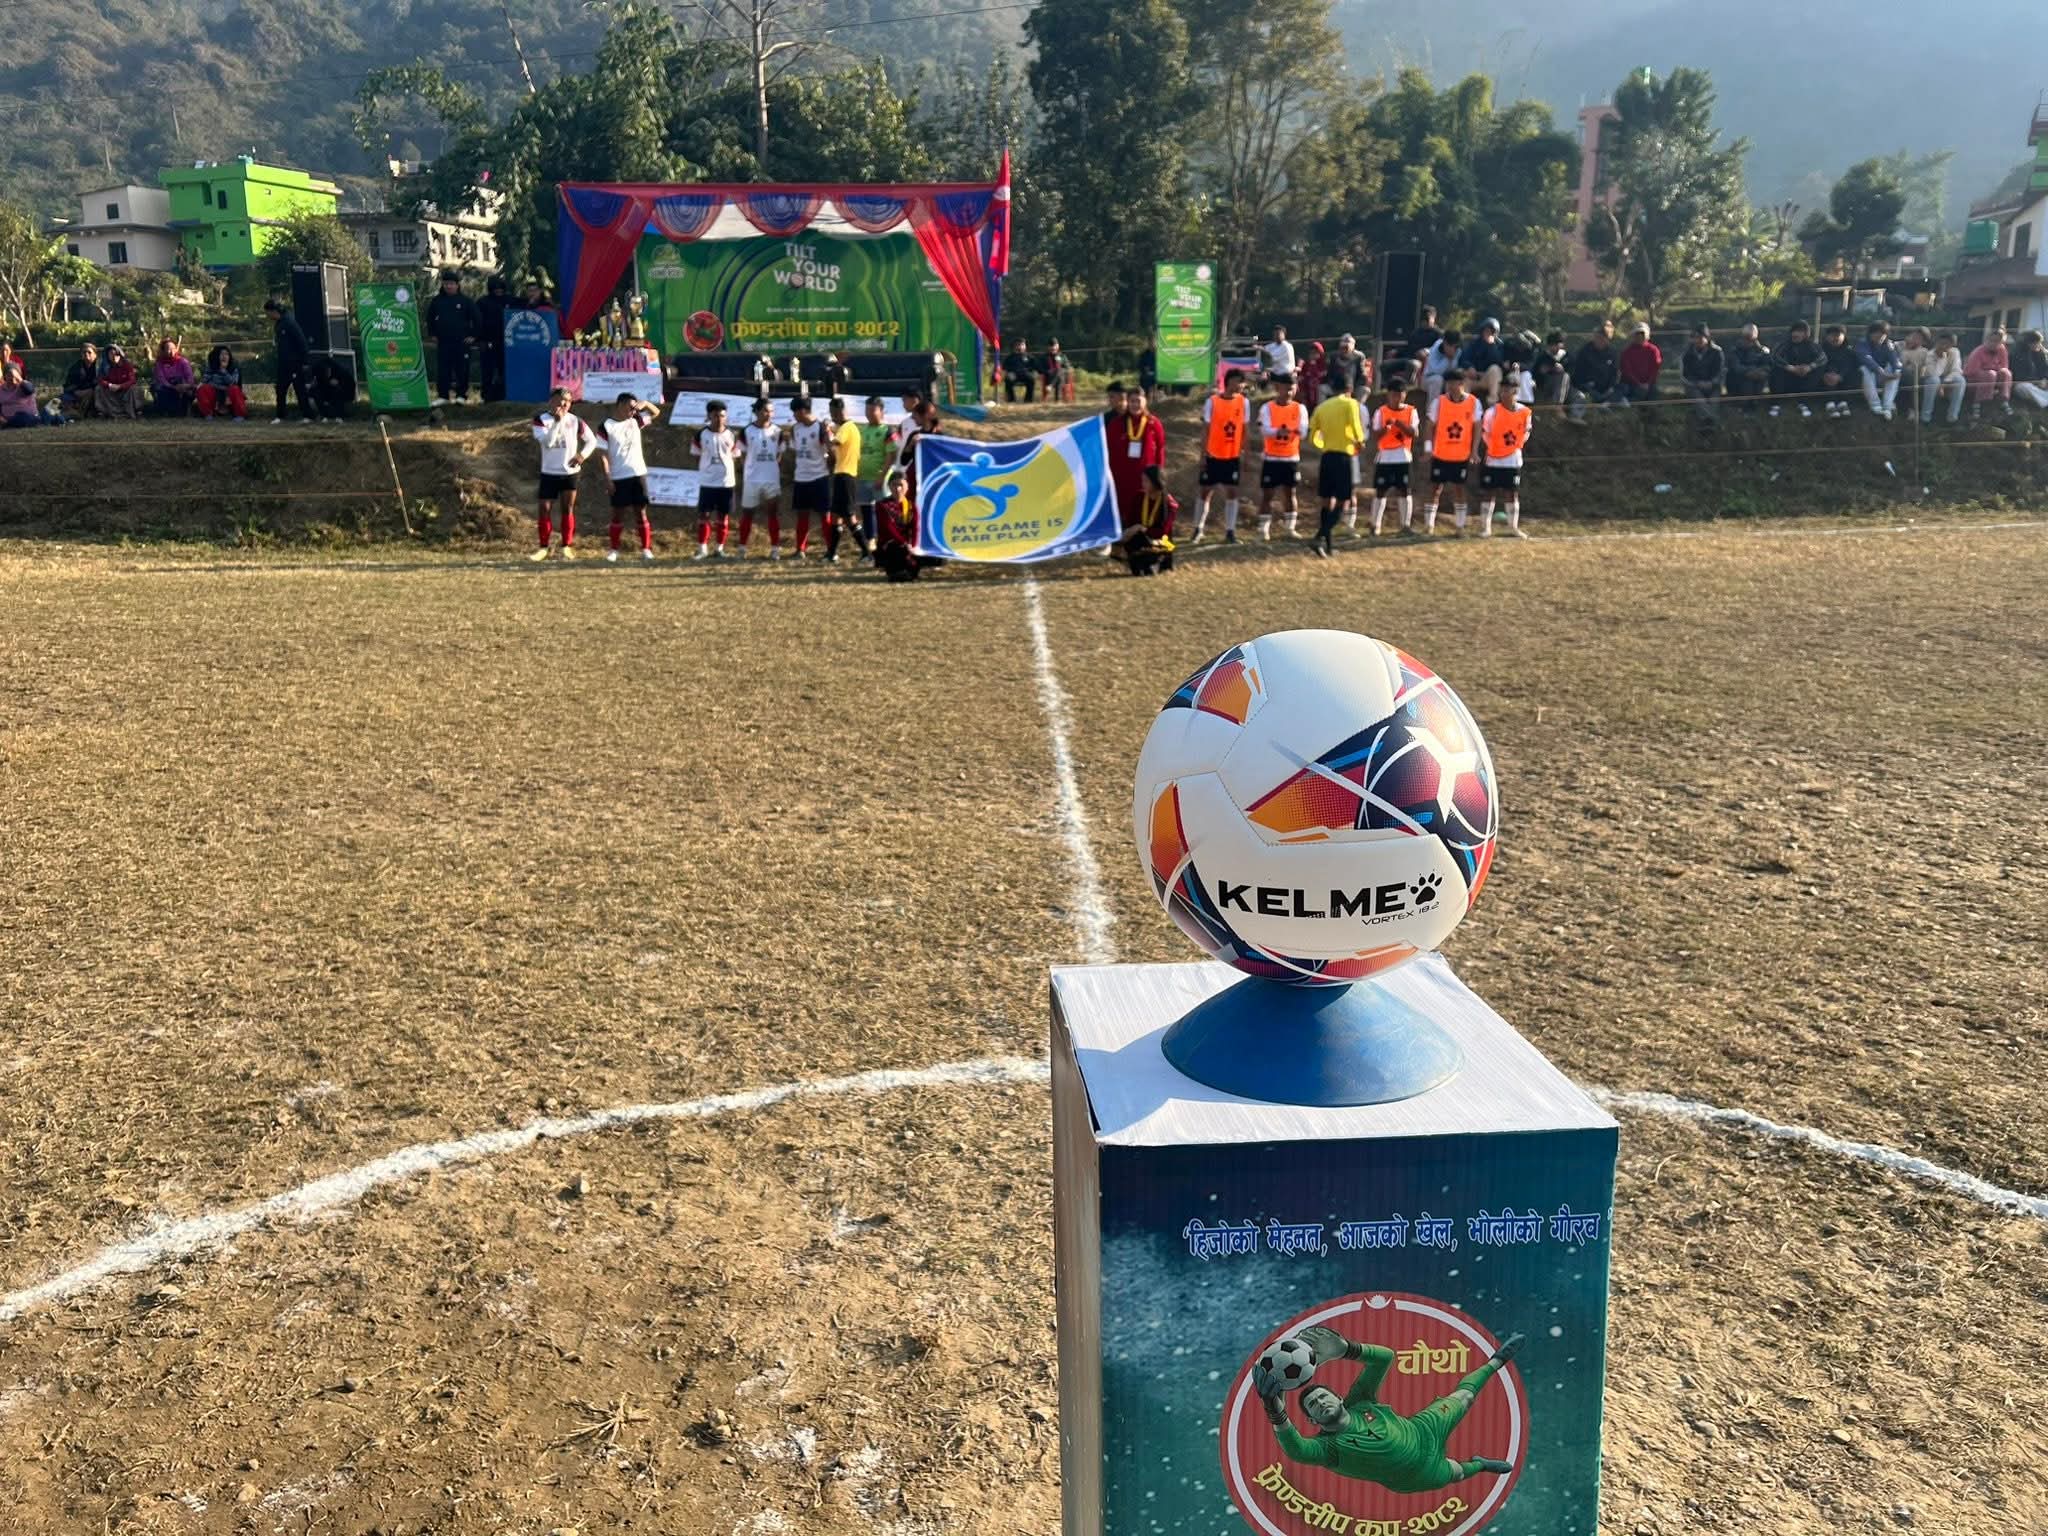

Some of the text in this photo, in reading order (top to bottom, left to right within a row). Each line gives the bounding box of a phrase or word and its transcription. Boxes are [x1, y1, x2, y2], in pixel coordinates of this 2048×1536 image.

[783, 242, 817, 260] TILT
[793, 258, 841, 280] YOUR
[952, 517, 1065, 534] MY GAME IS
[951, 529, 1041, 543] FAIR PLAY
[1218, 879, 1407, 919] KELME
[1361, 910, 1415, 926] VORTEX
[1338, 1213, 1409, 1250] आजको
[1467, 1207, 1544, 1247] भोलीको
[1396, 1339, 1471, 1375] चौथो
